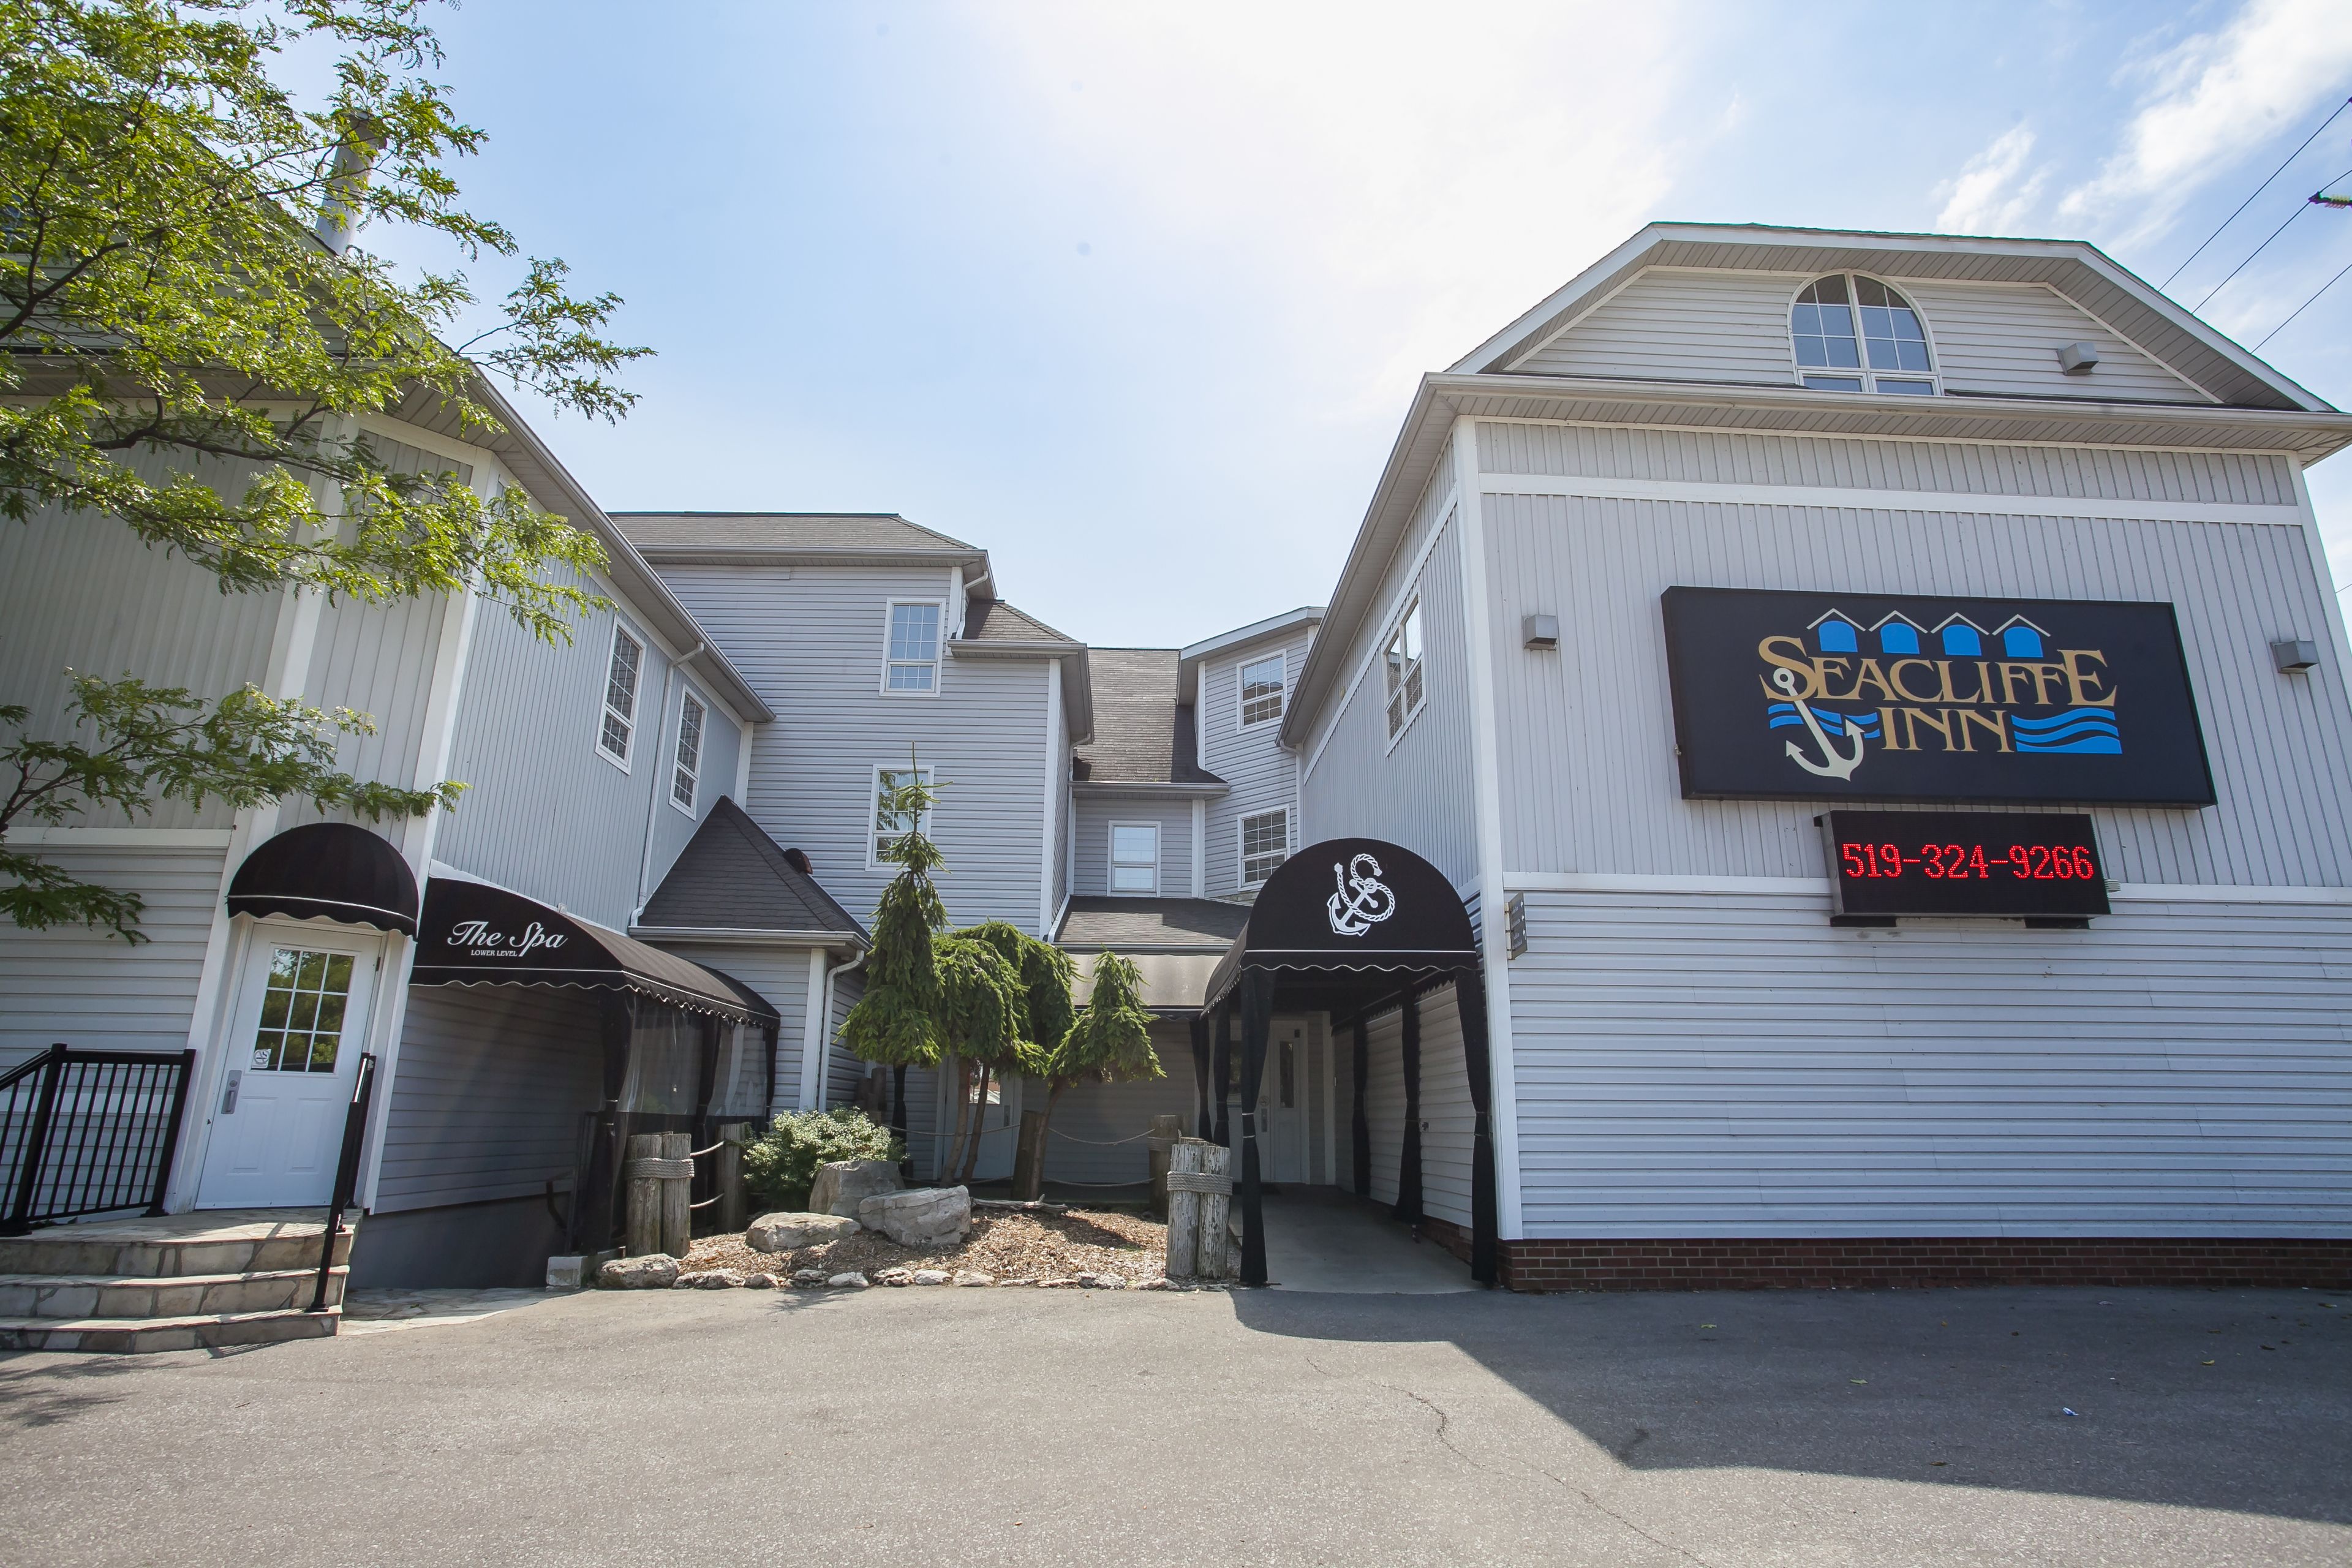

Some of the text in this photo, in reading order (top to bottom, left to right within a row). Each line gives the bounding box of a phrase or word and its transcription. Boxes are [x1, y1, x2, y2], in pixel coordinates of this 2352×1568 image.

[1758, 635, 2117, 706] SEACLIFFE
[1876, 706, 2015, 753] INN
[1842, 843, 2094, 880] 519-324-9266
[447, 921, 568, 957] The Spa
